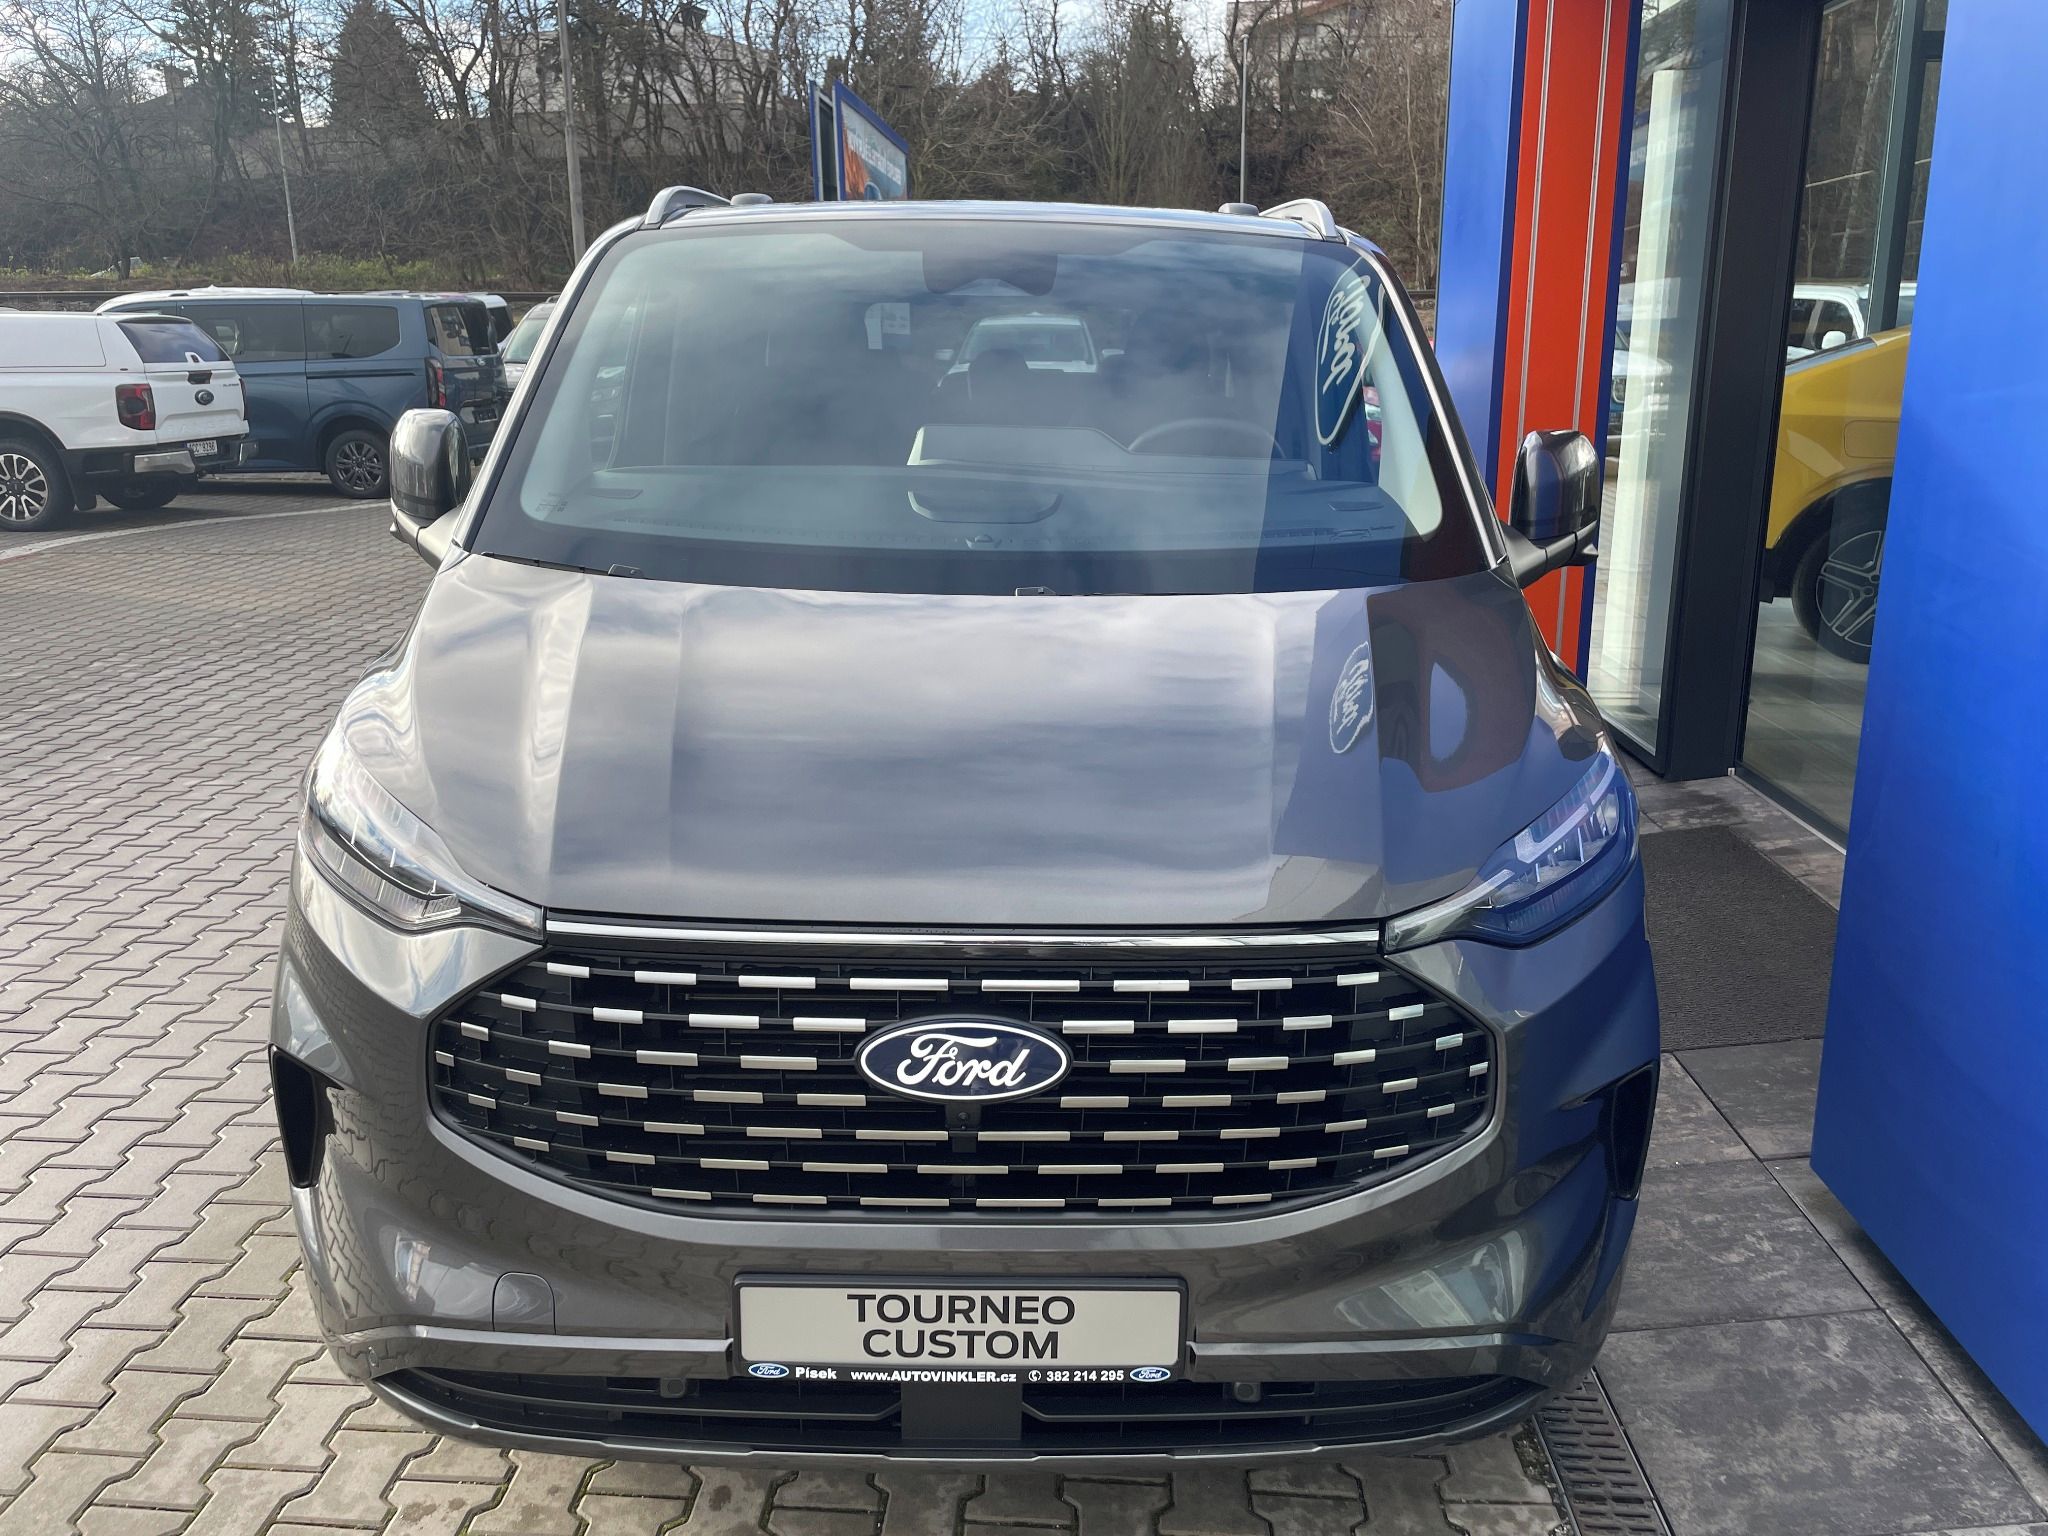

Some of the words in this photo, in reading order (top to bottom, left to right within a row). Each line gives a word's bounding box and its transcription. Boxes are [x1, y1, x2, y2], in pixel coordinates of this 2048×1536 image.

[896, 1033, 1030, 1086] Ford
[846, 1293, 1075, 1325] TOURNEO
[862, 1329, 1059, 1359] CUSTOM
[795, 1366, 837, 1380] Písek
[850, 1370, 1017, 1383] www.AUTOVINKLER.cz
[1046, 1369, 1070, 1382] 382
[1073, 1369, 1097, 1382] 214
[1100, 1369, 1124, 1381] 295
